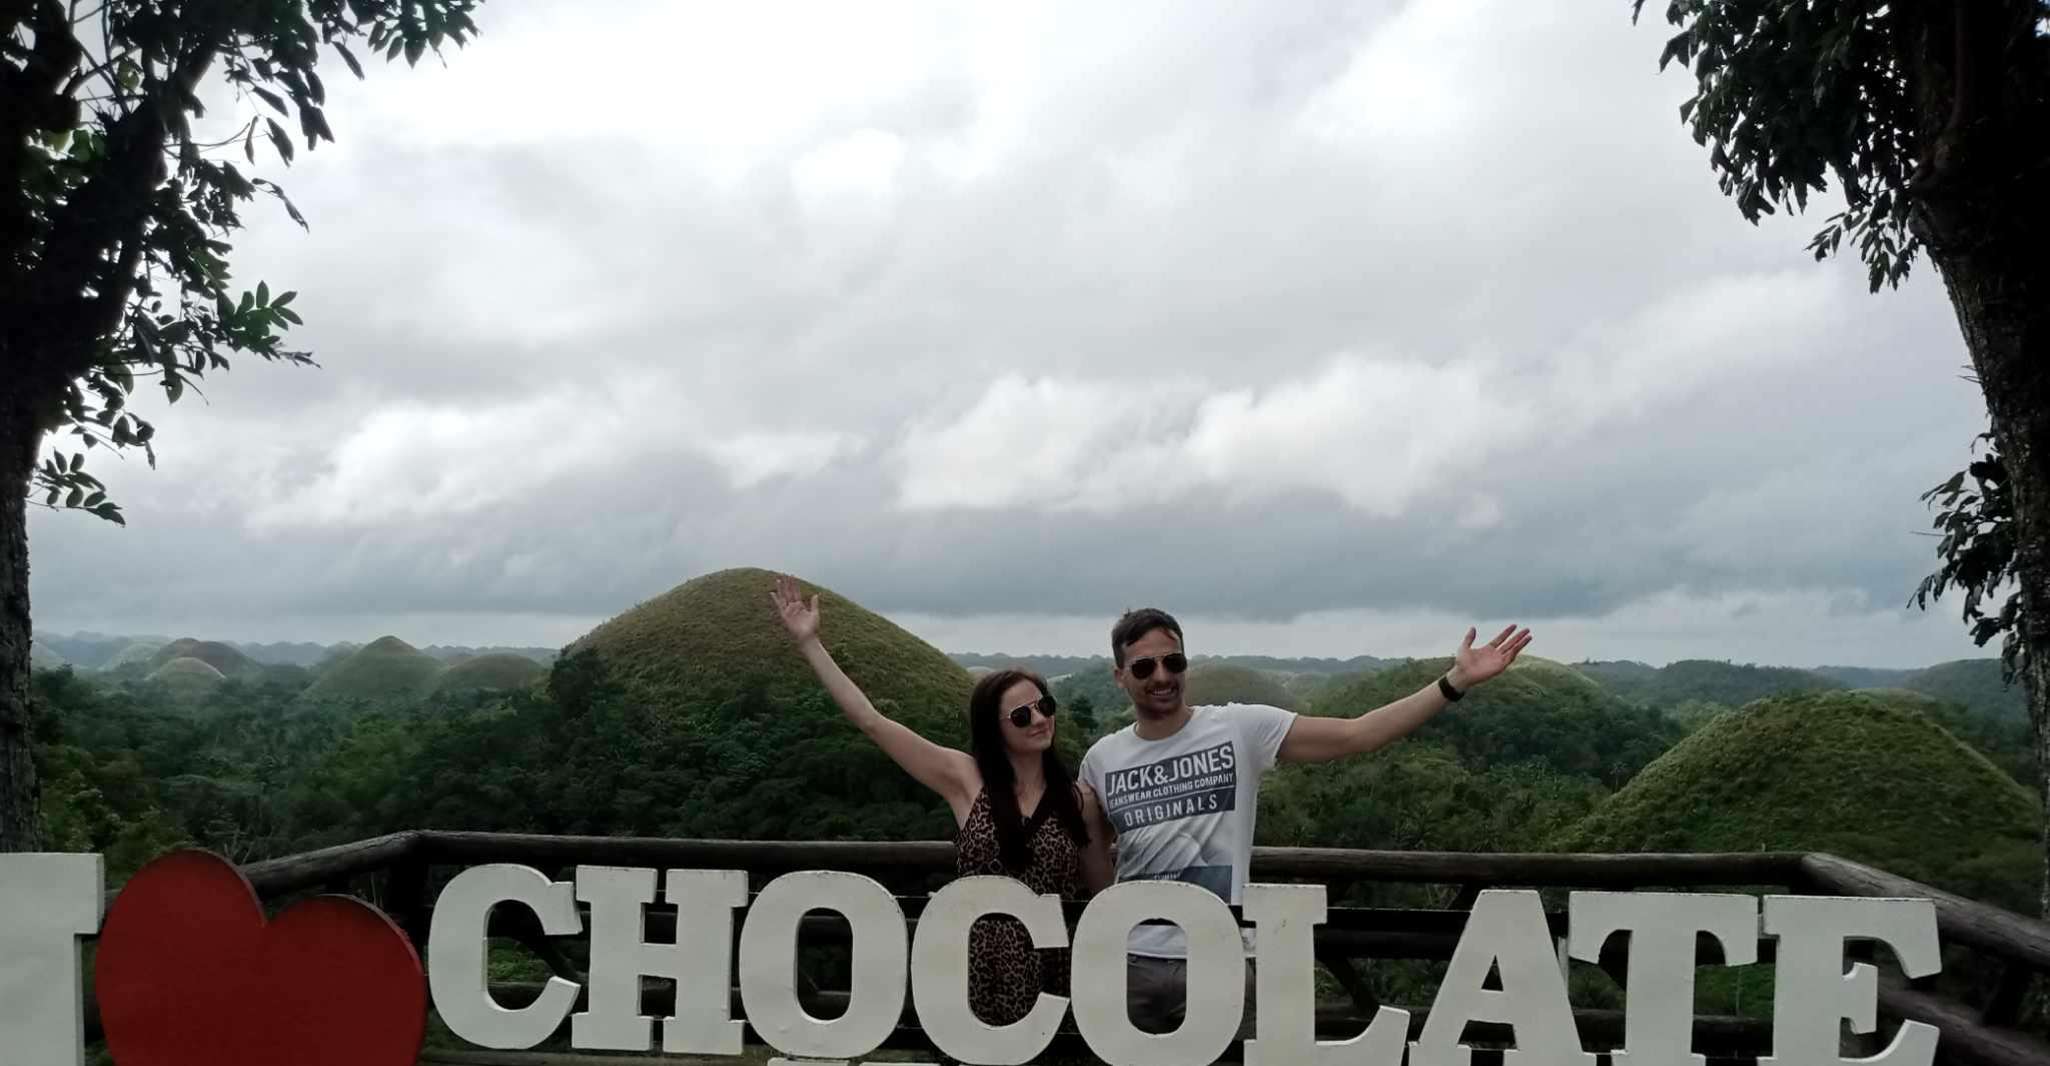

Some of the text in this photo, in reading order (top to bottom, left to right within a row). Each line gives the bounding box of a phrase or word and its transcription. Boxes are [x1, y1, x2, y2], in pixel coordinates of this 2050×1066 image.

[1108, 746, 1234, 795] JACK&JONES
[1153, 781, 1193, 797] CLOTHING
[1194, 773, 1233, 788] COMPANY
[1124, 794, 1217, 826] ORIGINALS
[428, 863, 1943, 1066] CHOCOLATE
